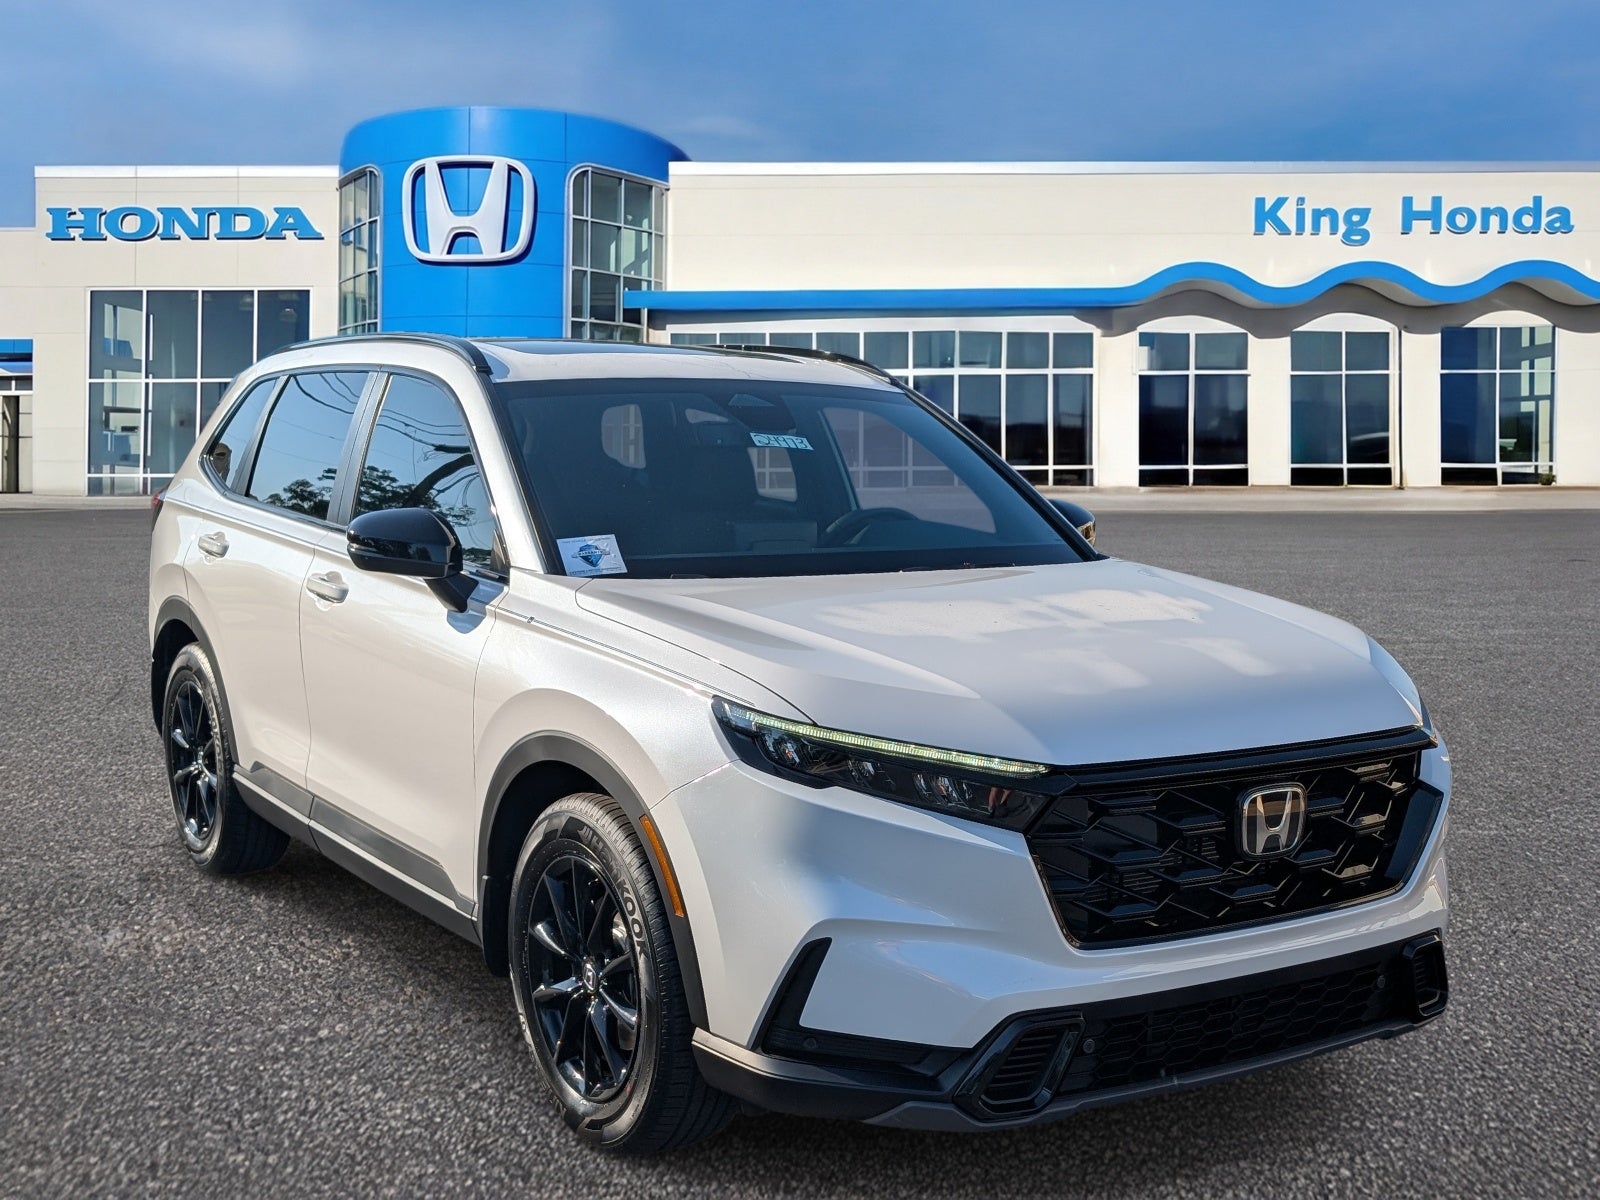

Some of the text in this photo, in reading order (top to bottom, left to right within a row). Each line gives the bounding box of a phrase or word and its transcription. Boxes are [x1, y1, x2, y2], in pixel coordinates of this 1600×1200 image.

[46, 206, 324, 241] HONDA
[1254, 195, 1575, 246] King Honda
